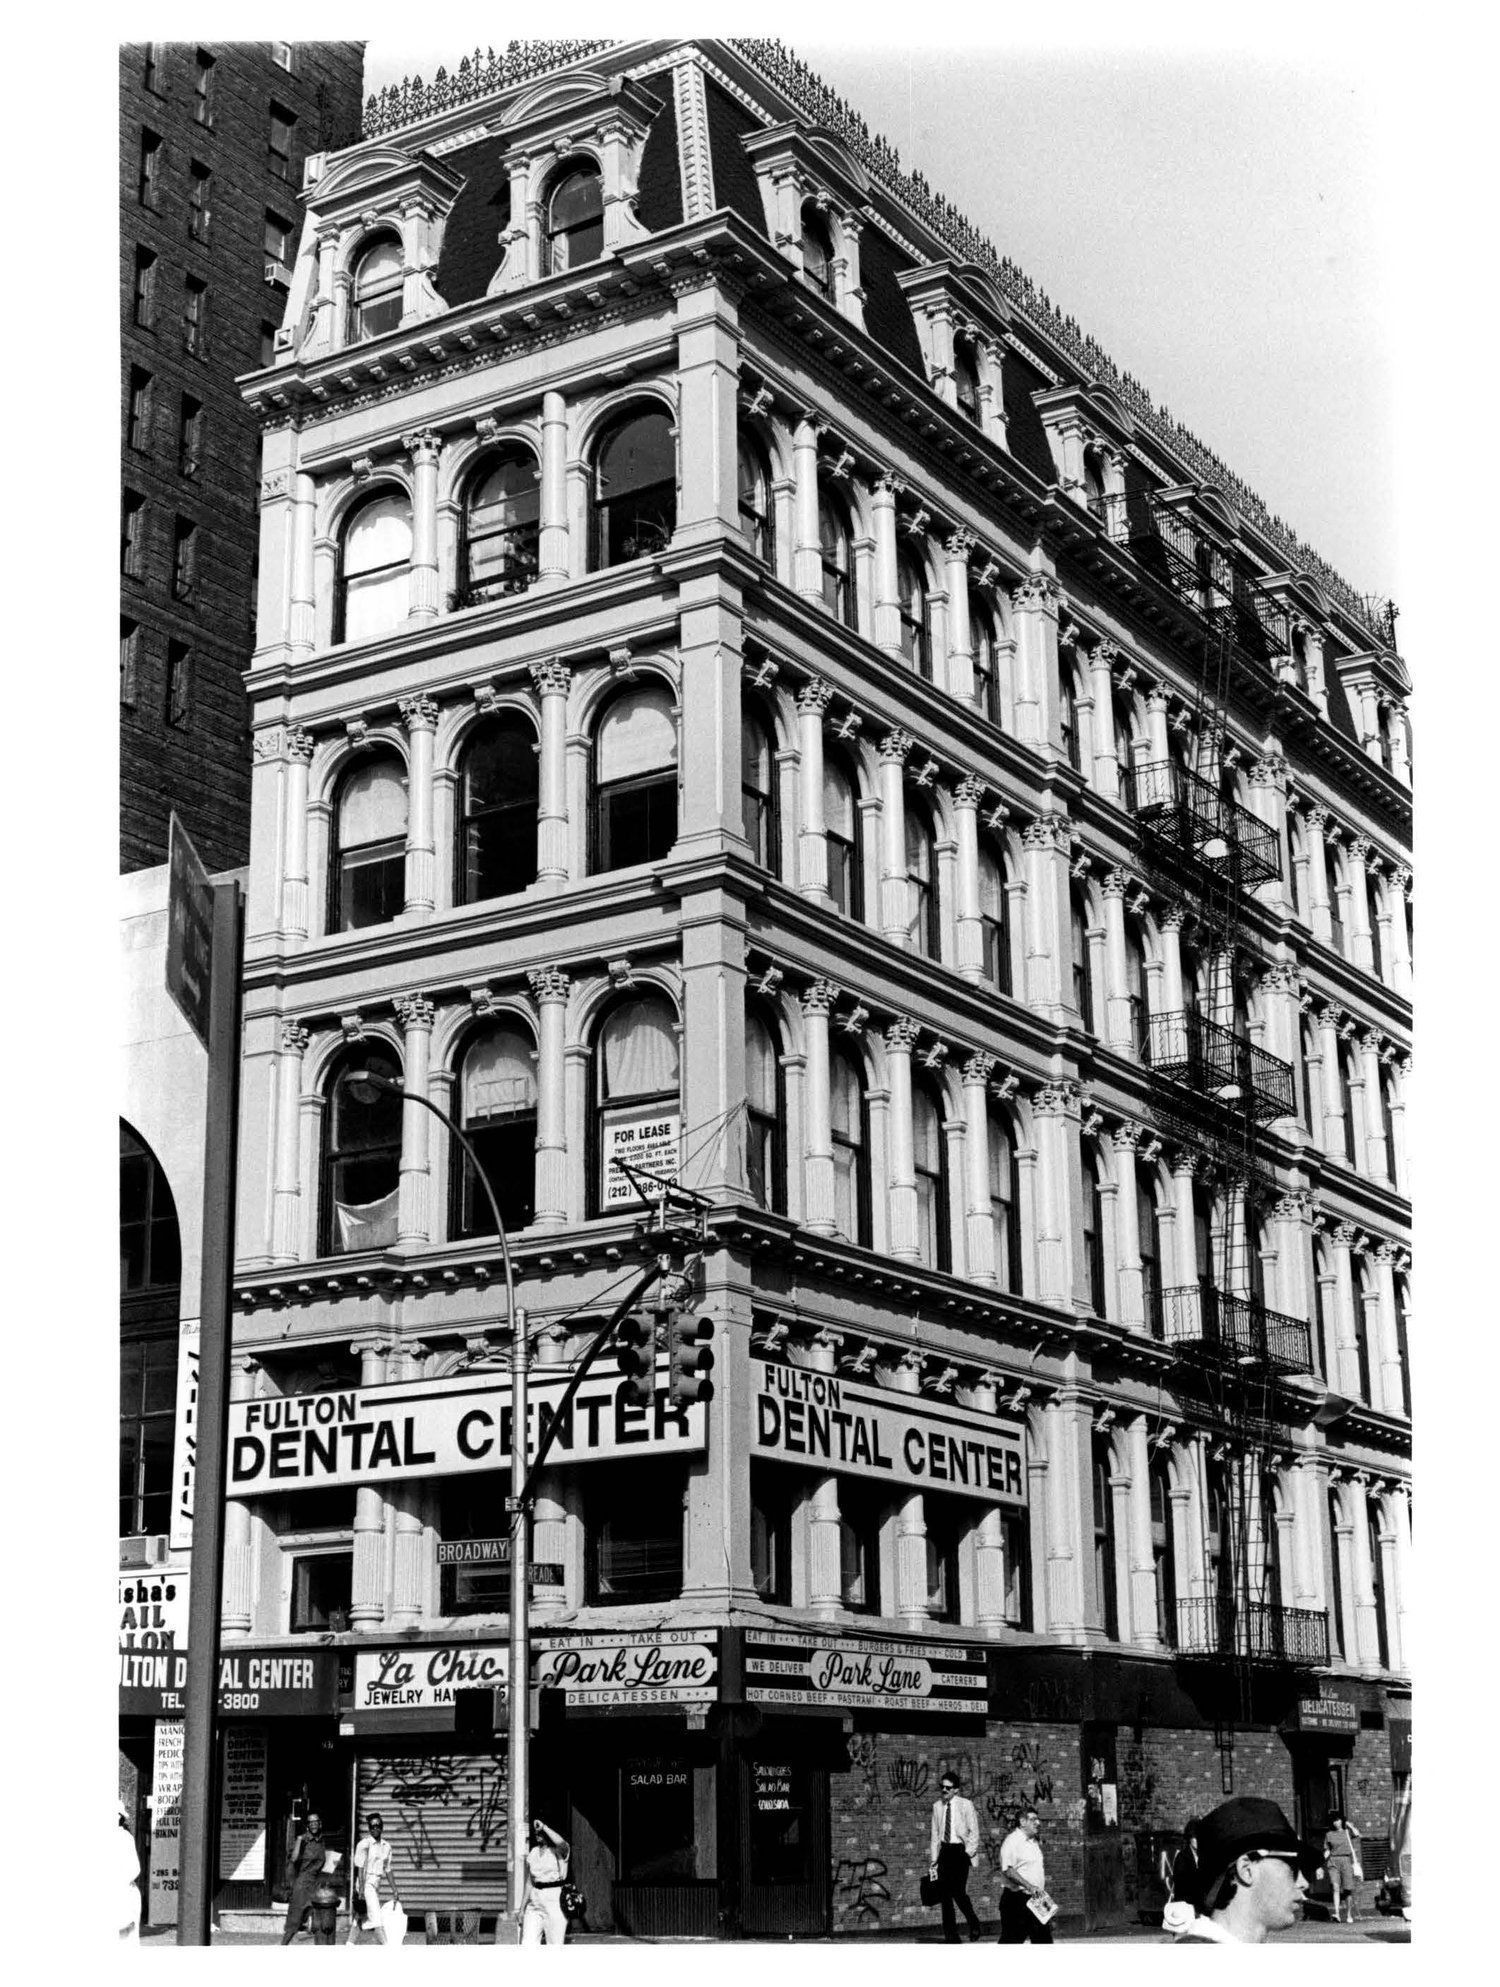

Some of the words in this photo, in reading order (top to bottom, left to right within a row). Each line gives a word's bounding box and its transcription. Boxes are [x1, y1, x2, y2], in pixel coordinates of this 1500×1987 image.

[614, 1130, 634, 1143] FOR
[639, 1124, 671, 1139] LEASE
[608, 1184, 632, 1199] (212)
[765, 1364, 840, 1409] FULTON
[246, 1393, 356, 1432] FULTON
[232, 1417, 436, 1482] DENTAL
[457, 1388, 689, 1459] CENTER
[758, 1394, 892, 1469] DENTAL
[904, 1428, 1022, 1496] CENTER
[439, 1542, 506, 1561] BROADWAY
[528, 1566, 554, 1583] READE
[550, 1636, 572, 1648] EAT
[580, 1636, 594, 1647] IN
[630, 1633, 662, 1644] TAKE
[670, 1631, 697, 1642] OUT
[747, 1630, 762, 1641] EAT
[768, 1632, 776, 1643] IN
[799, 1636, 817, 1646] TAKE
[822, 1638, 838, 1648] OUT
[858, 1640, 894, 1653] BURGERS
[905, 1644, 926, 1656] FRIES
[249, 1658, 314, 1689] CENTER
[367, 1651, 416, 1691] La
[427, 1650, 504, 1686] Chic
[542, 1648, 627, 1687] Park
[624, 1648, 706, 1688] Lane
[752, 1662, 764, 1671] WE
[769, 1662, 804, 1674] DELIVER
[820, 1652, 872, 1689] Park
[872, 1657, 922, 1694] Lane
[942, 1674, 978, 1686] CATERERS
[161, 1692, 186, 1709] TEL.
[364, 1690, 424, 1706] JEWELRY
[568, 1690, 678, 1704] DELICATESSEN
[748, 1689, 764, 1700] HOT
[768, 1690, 802, 1702] CORNED
[806, 1692, 827, 1702] BEEF
[838, 1694, 874, 1704] PASTRAMI
[885, 1697, 907, 1707] ROAST
[912, 1698, 930, 1708] BEEF
[938, 1700, 962, 1710] HEROS
[970, 1702, 986, 1712] DELI
[1302, 1700, 1356, 1718] DELICATESSEN
[158, 1738, 182, 1746] FRENCH
[630, 1774, 663, 1786] SALAD
[666, 1774, 687, 1784] BAR
[158, 1795, 180, 1804] BODY
[156, 1829, 178, 1838] BIKINI
